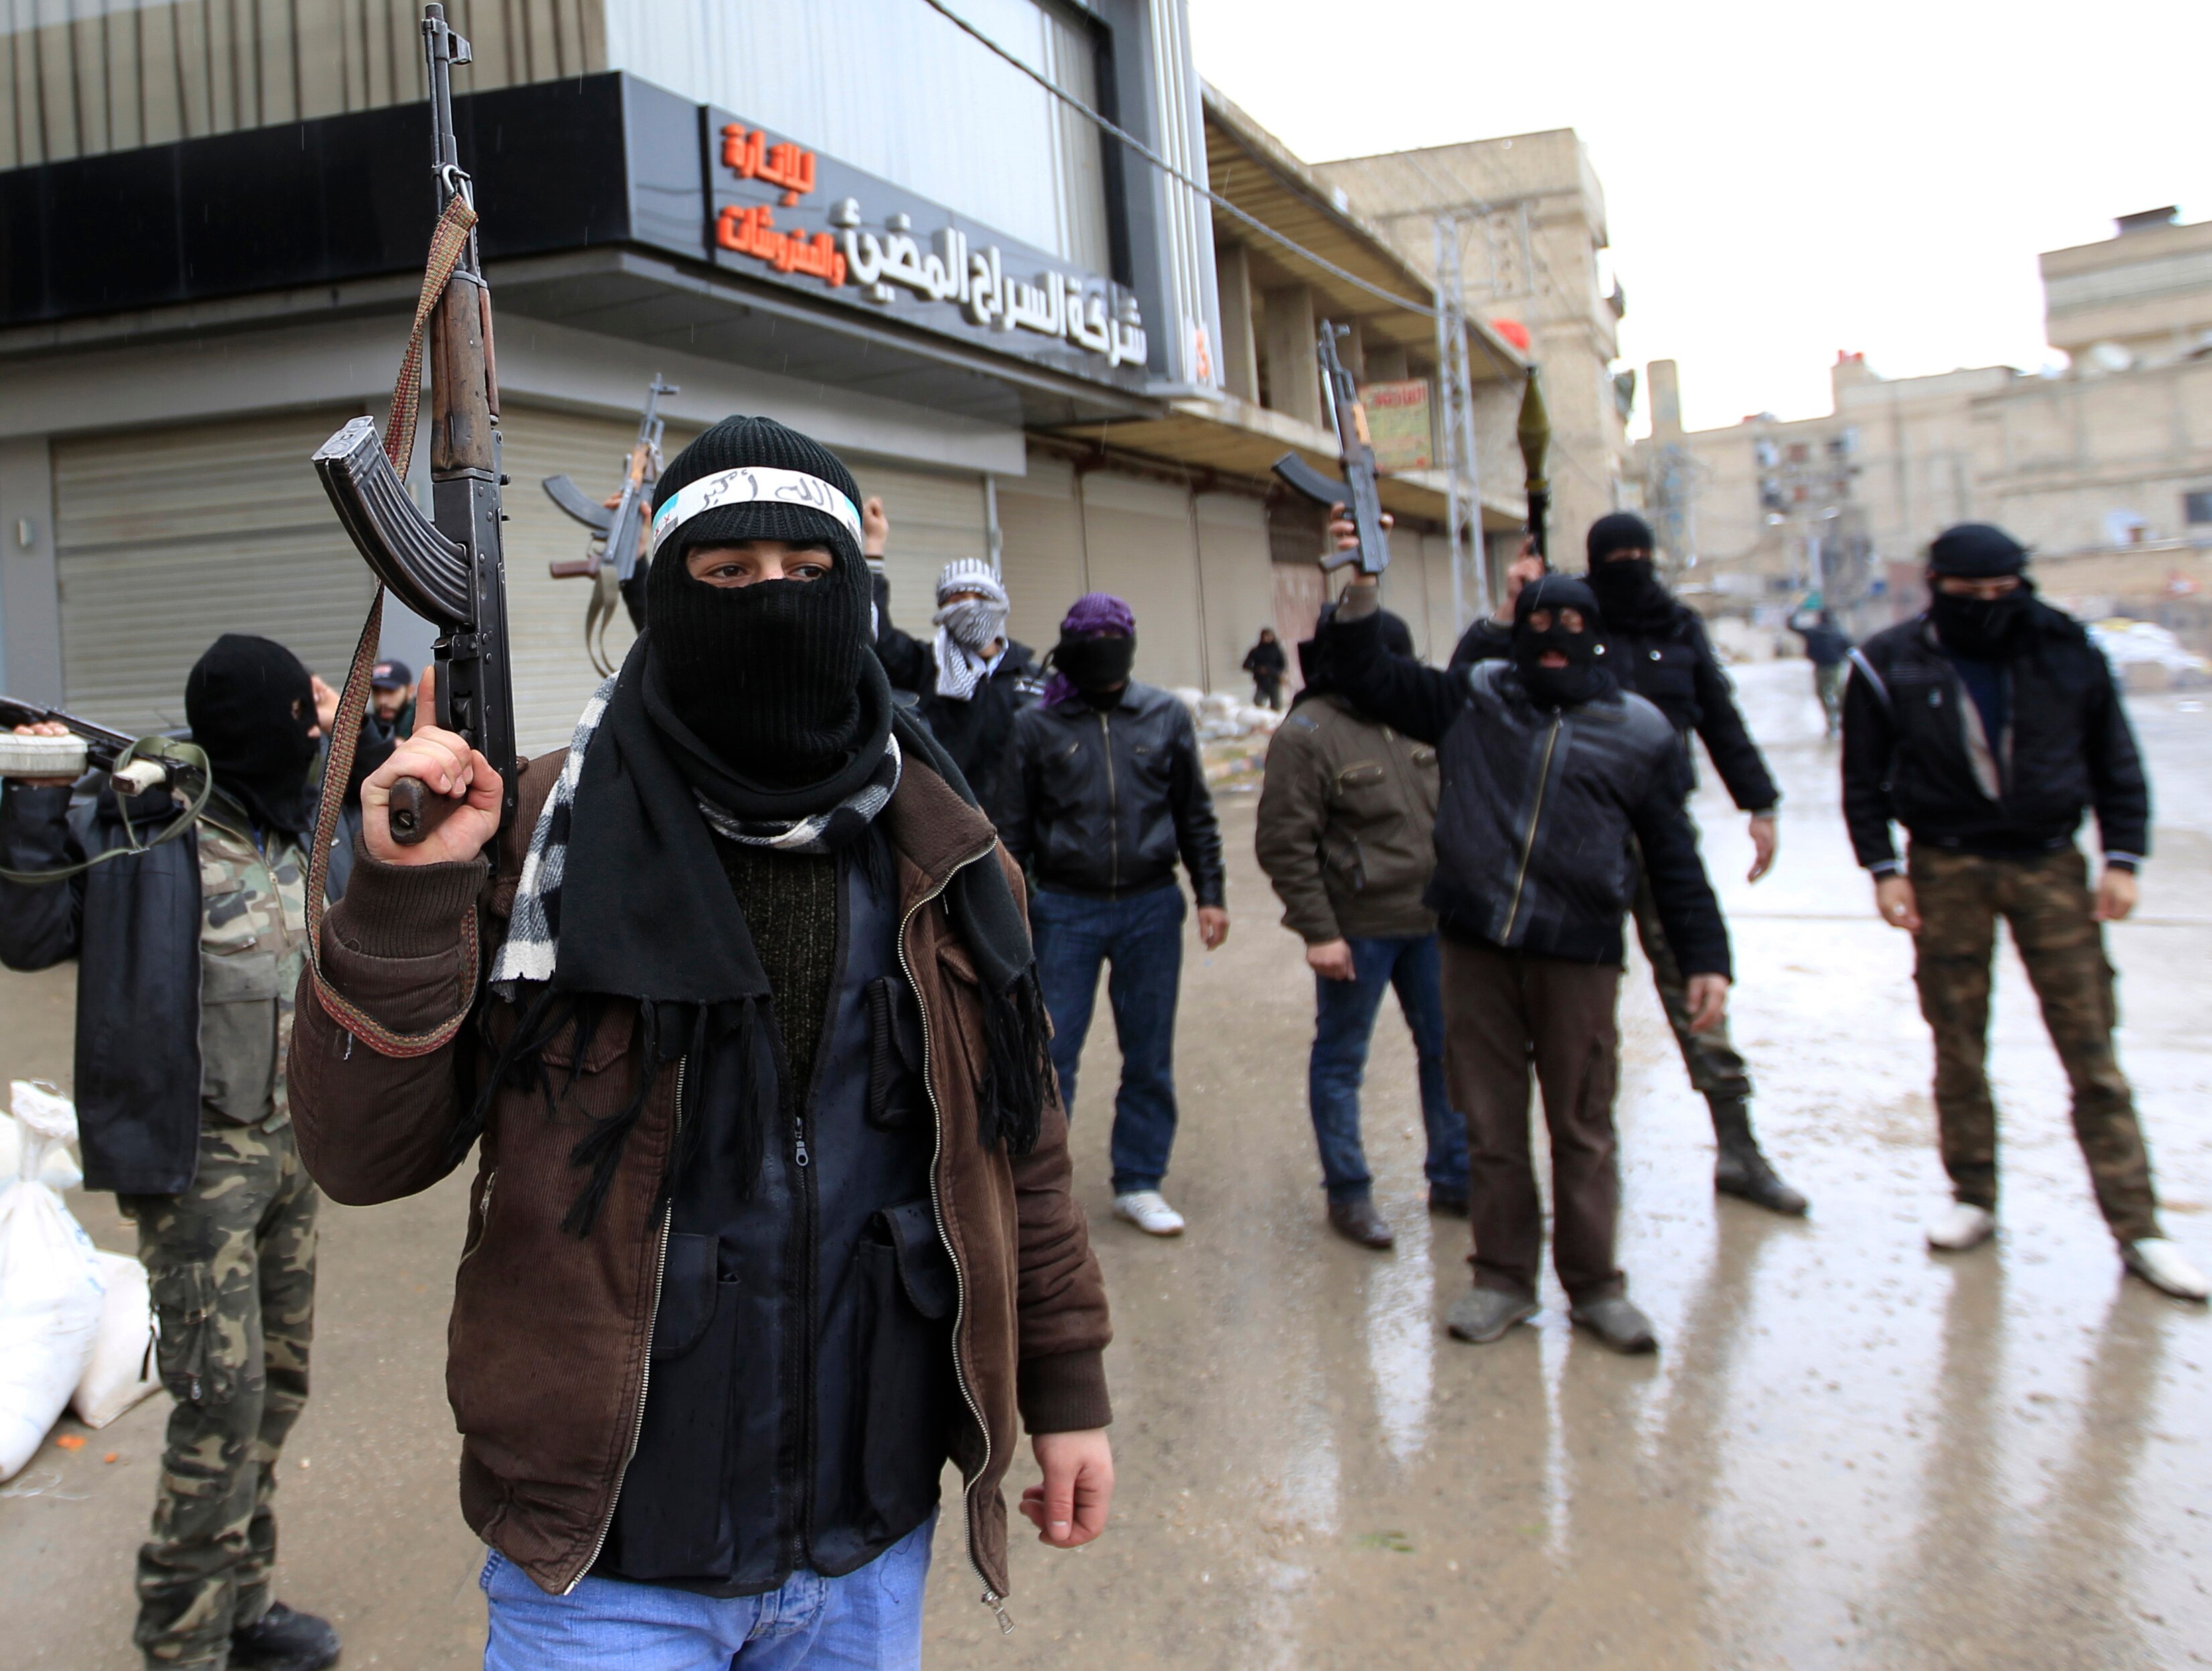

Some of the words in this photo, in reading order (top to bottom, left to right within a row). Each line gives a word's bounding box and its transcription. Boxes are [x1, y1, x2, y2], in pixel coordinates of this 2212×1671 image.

[716, 204, 846, 287] والمفروشات
[971, 245, 1067, 336] السراج
[1066, 276, 1147, 367] شركة
[775, 477, 834, 512] الله
